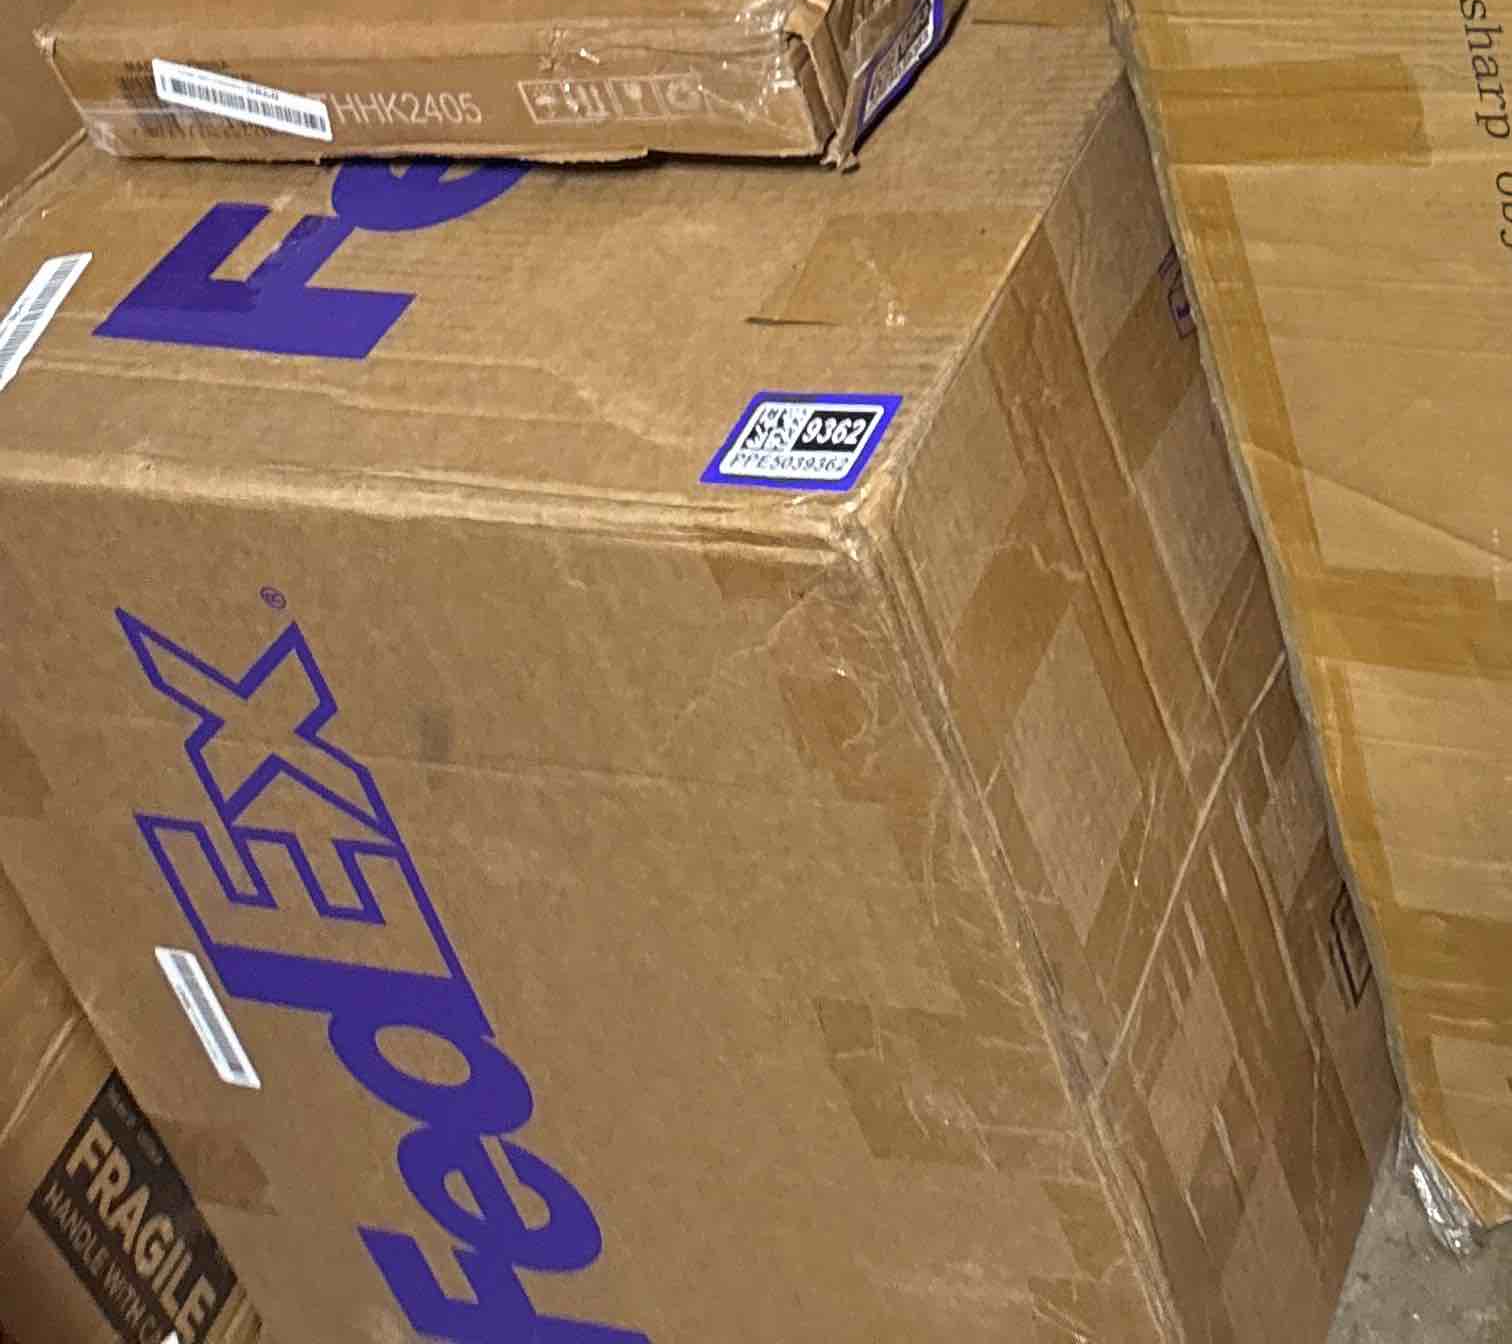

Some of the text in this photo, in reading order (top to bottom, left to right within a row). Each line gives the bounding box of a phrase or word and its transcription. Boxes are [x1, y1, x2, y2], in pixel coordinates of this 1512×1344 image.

[801, 416, 868, 446] 9362
[44, 1183, 148, 1328] HANDLE WITH
[65, 1118, 218, 1344] FRAGILE
